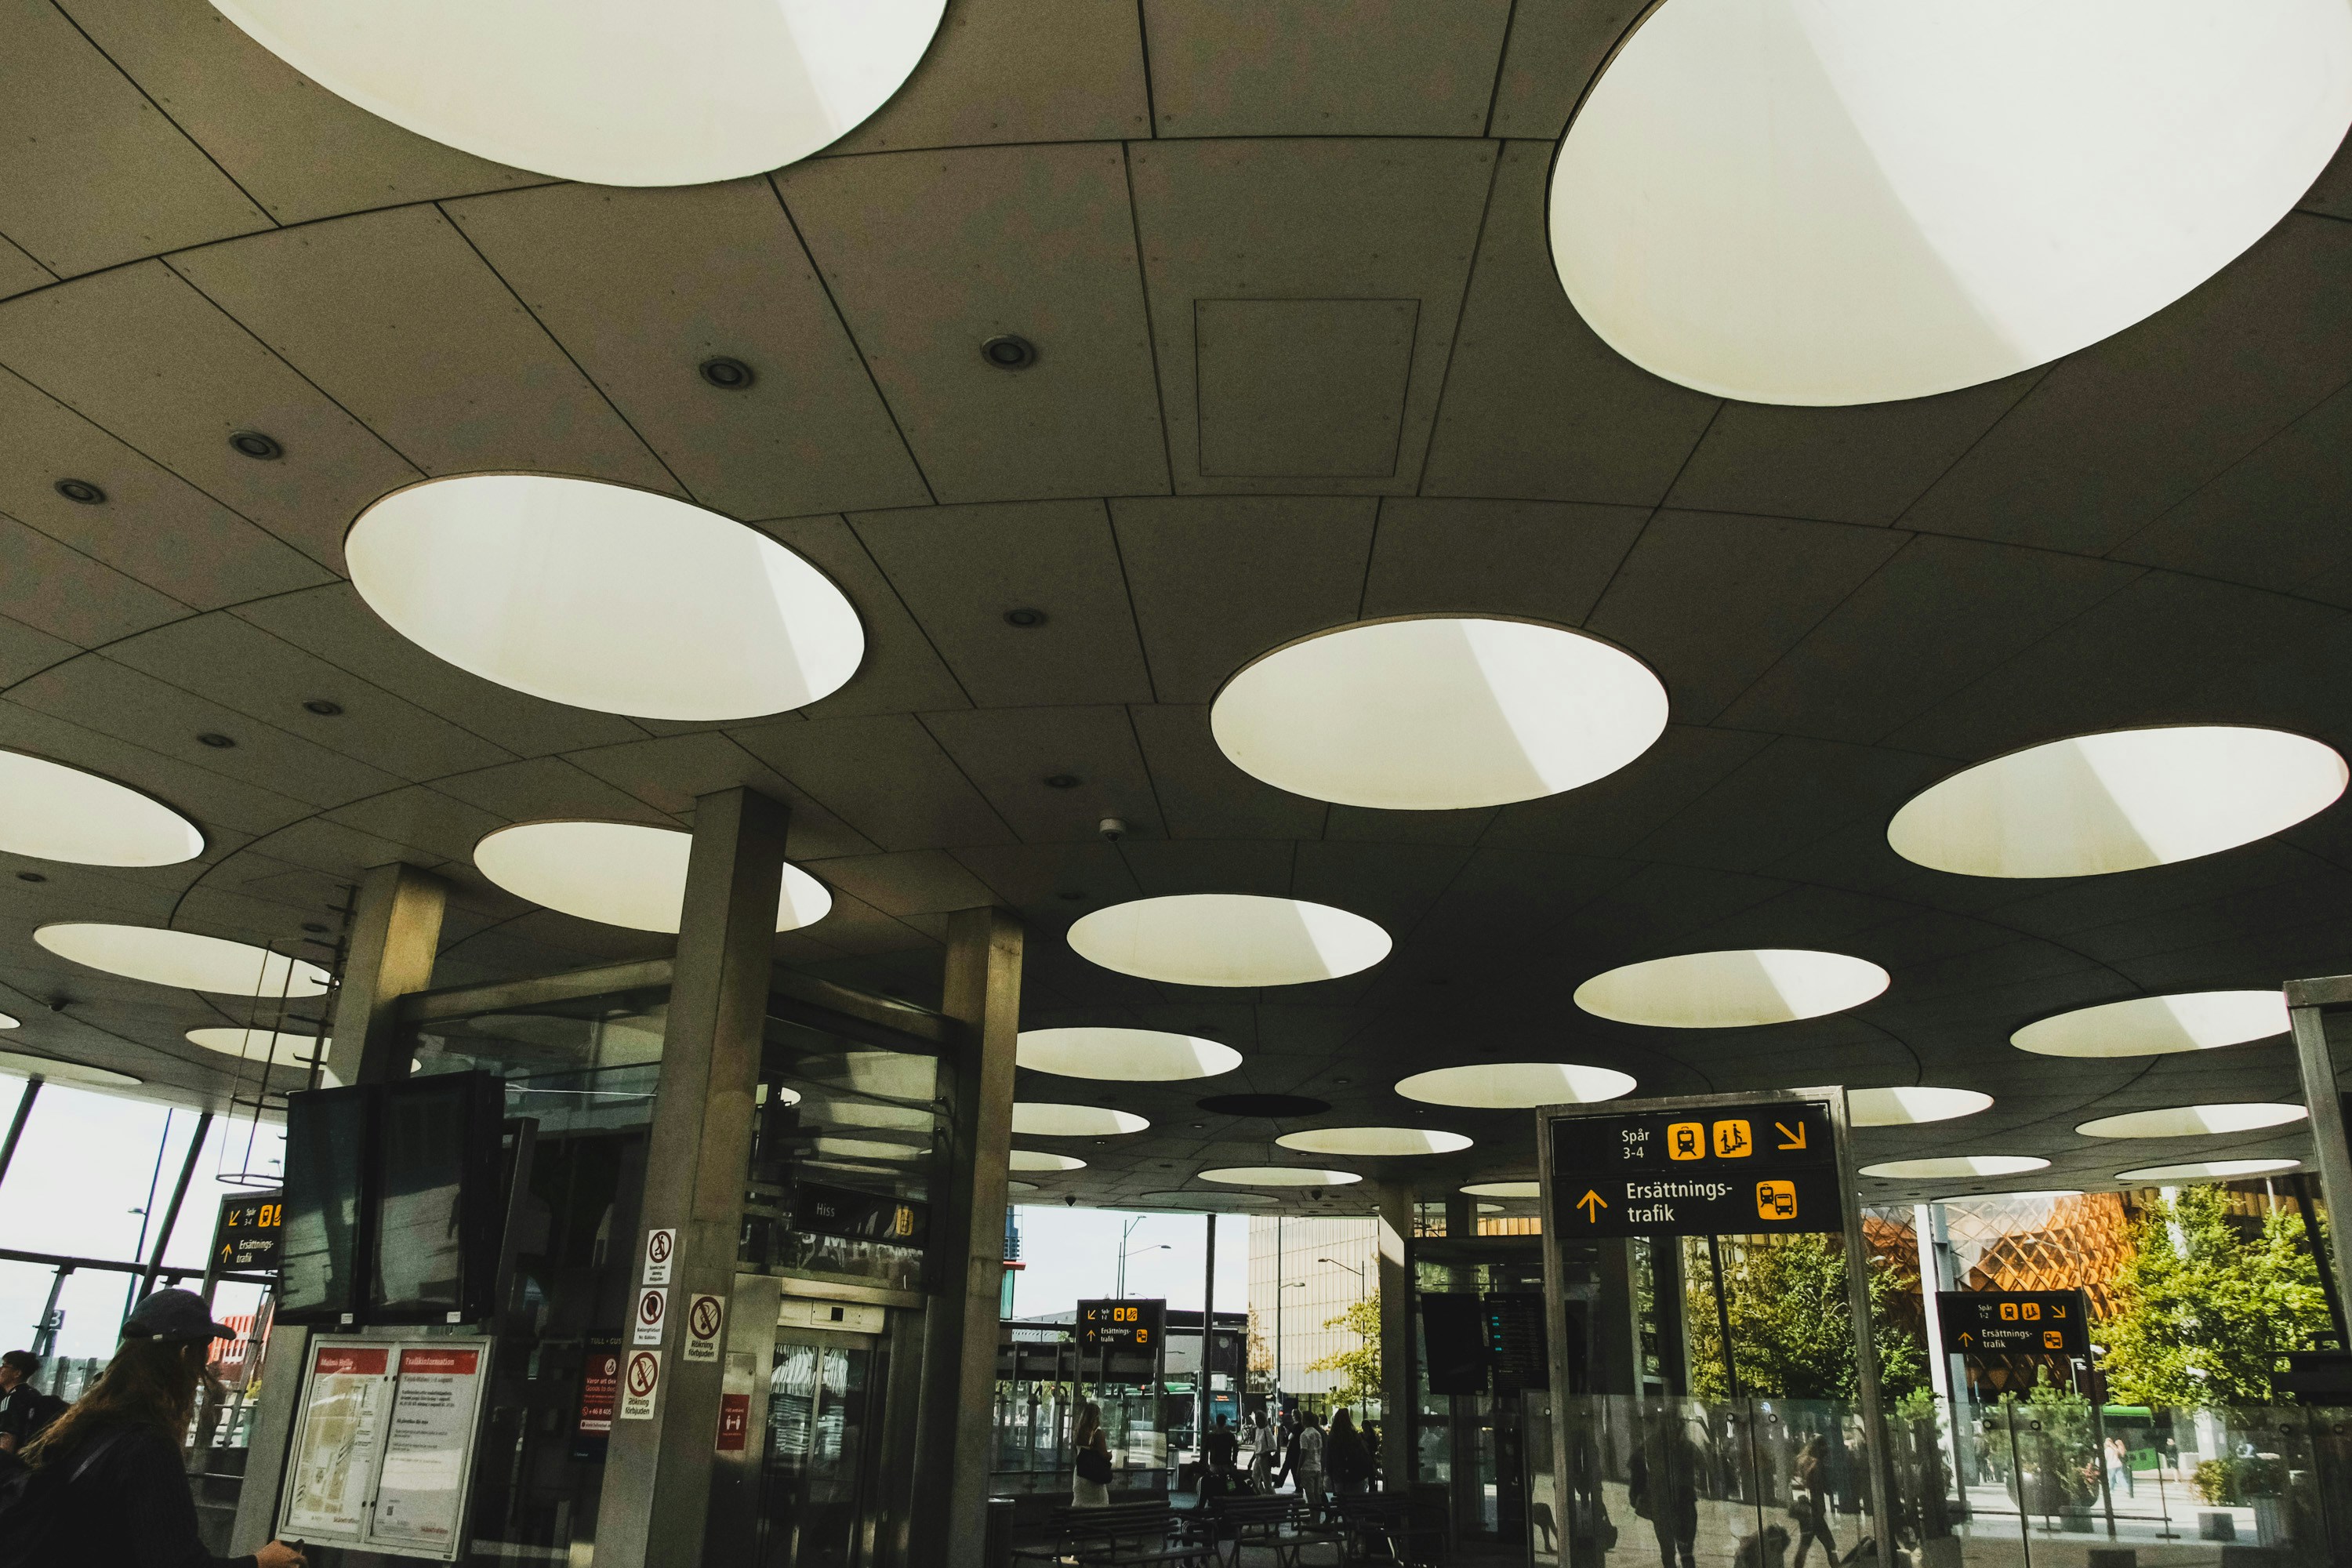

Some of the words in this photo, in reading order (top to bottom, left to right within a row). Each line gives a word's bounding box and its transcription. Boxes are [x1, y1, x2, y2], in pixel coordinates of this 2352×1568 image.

[1621, 1128, 1650, 1145] Spår
[1623, 1147, 1644, 1159] 3-4
[1626, 1180, 1733, 1201] Ersättnings-
[246, 1208, 257, 1217] Spår
[817, 1203, 835, 1218] Hiss
[1628, 1204, 1675, 1222] trafik
[238, 1240, 274, 1251] Ersättnings-
[236, 1252, 252, 1263] trafik
[49, 1310, 61, 1327] 3
[1101, 1327, 1131, 1336] Ersättnings-
[1982, 1329, 2032, 1339] Ersättnings-
[691, 1340, 713, 1350] Rökning
[1983, 1339, 2006, 1348] trafik
[688, 1348, 714, 1358] förbjuden
[405, 1357, 455, 1366] Trafikinformation
[628, 1397, 649, 1406] Rökning
[625, 1406, 650, 1415] förbjuden
